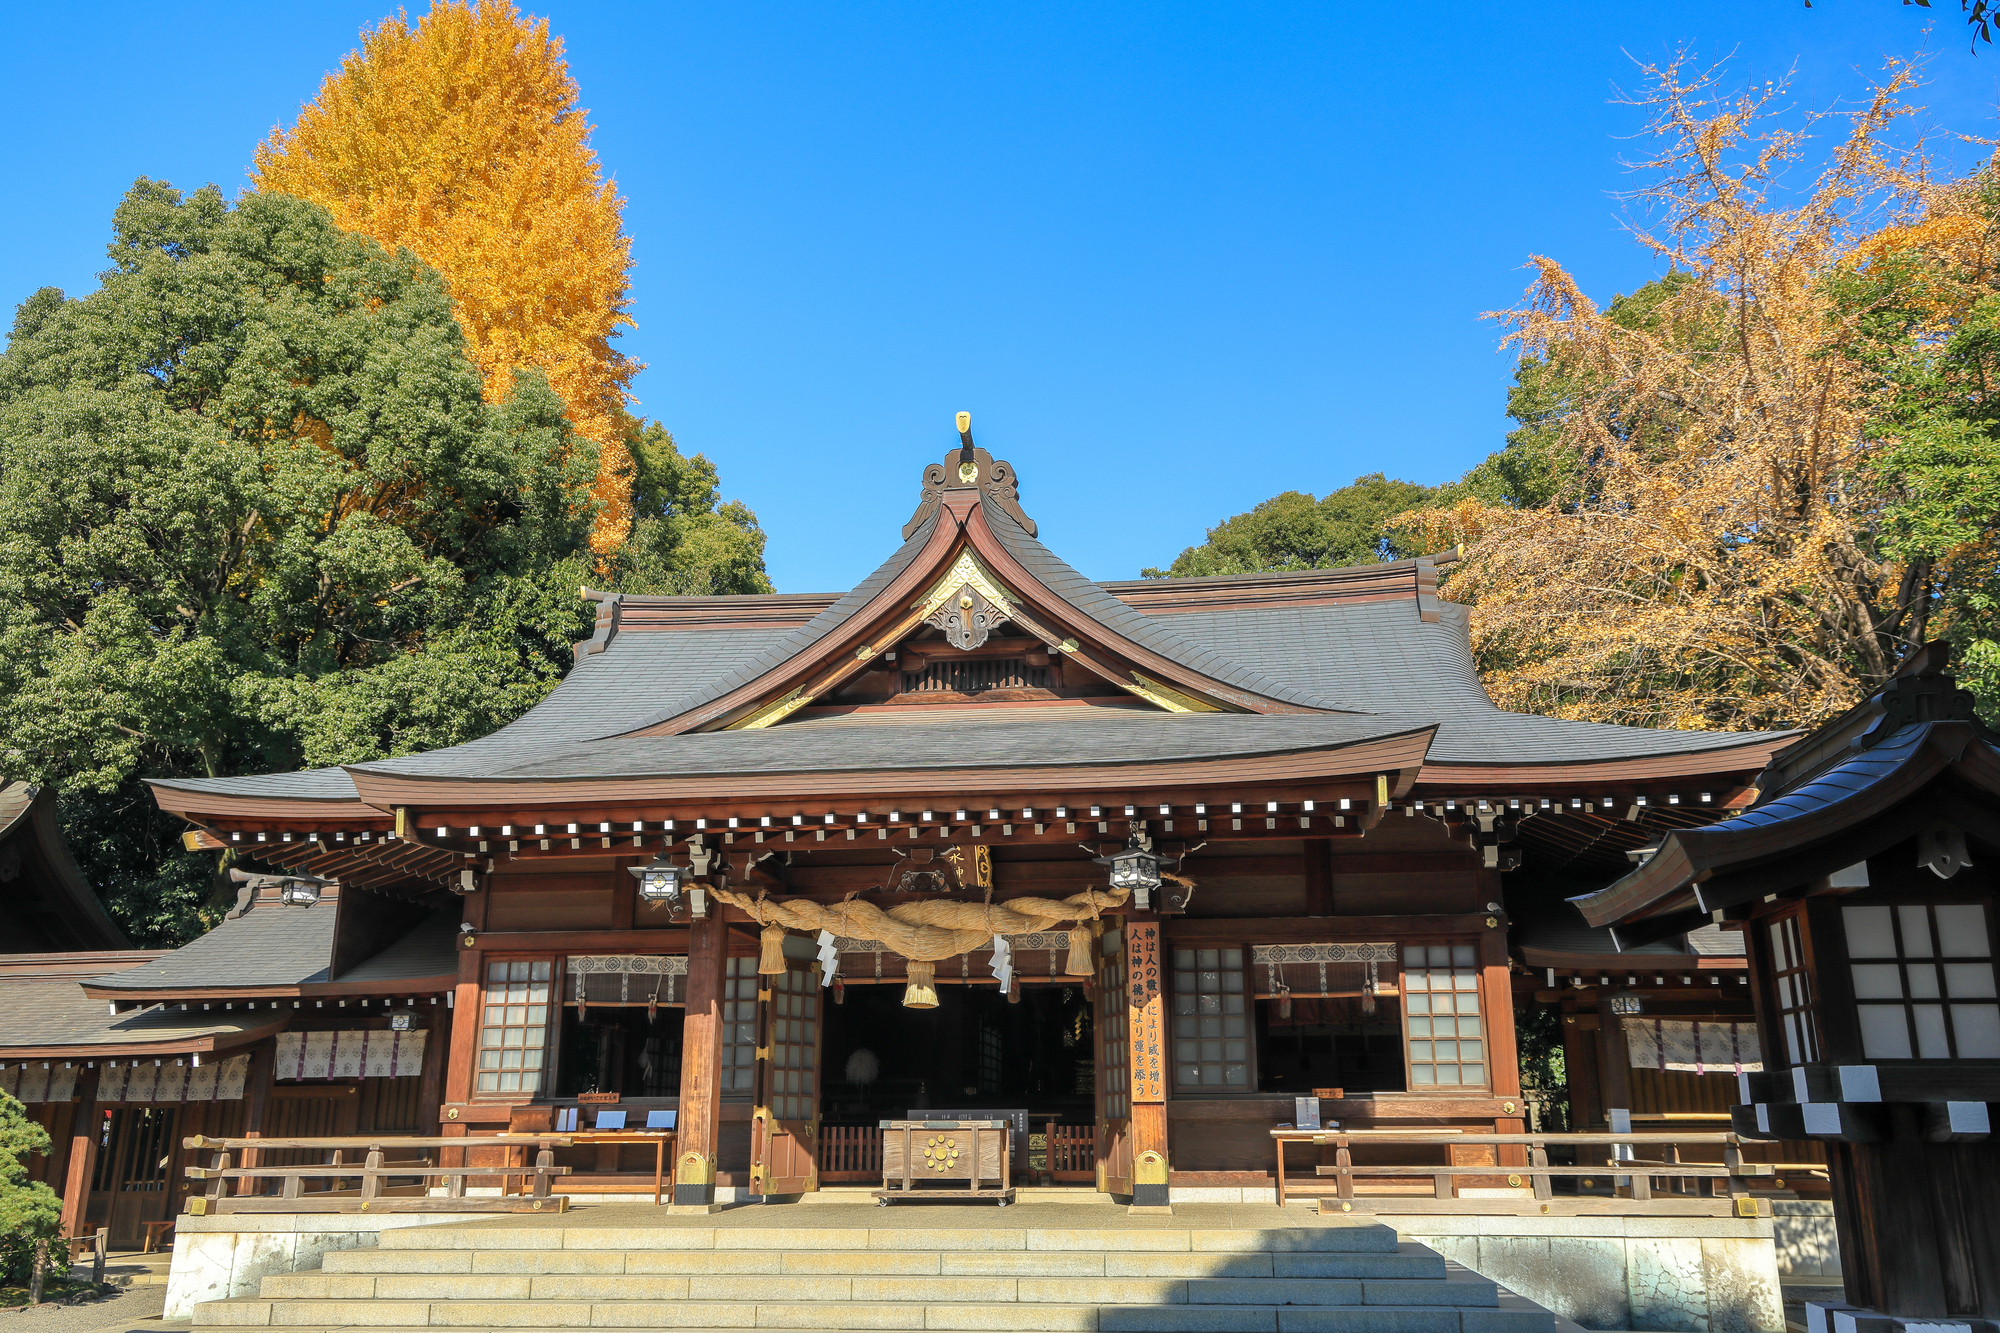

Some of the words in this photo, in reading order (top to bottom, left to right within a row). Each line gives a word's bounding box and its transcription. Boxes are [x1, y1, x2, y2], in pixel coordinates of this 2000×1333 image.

[1144, 927, 1160, 1096] 神は人の敬いにより威を増し
